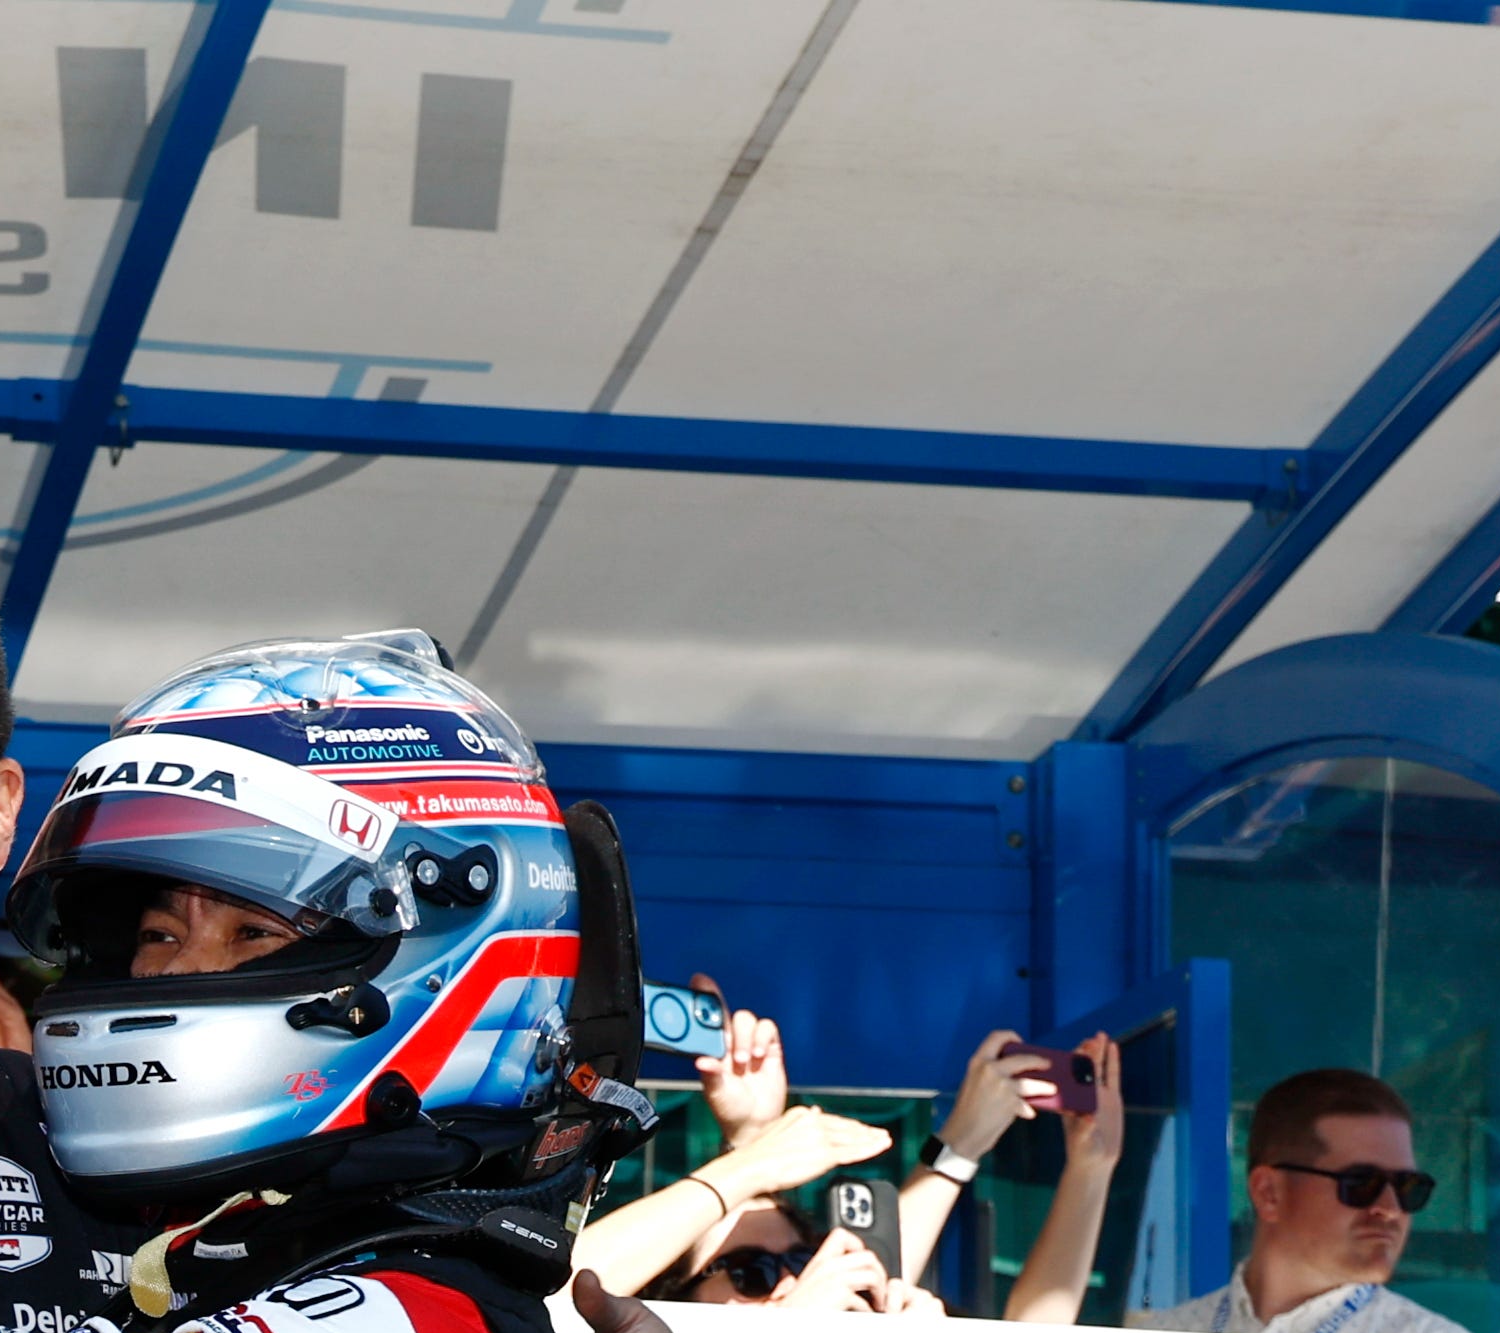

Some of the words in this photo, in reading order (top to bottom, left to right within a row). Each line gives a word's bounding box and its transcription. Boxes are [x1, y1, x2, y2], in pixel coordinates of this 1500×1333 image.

[305, 724, 430, 744] Panasonic
[307, 744, 443, 762] AUTOMOTIVE
[376, 794, 549, 816] ww.takumasato.com
[41, 1060, 176, 1090] HONDA
[500, 1220, 558, 1249] ZERO
